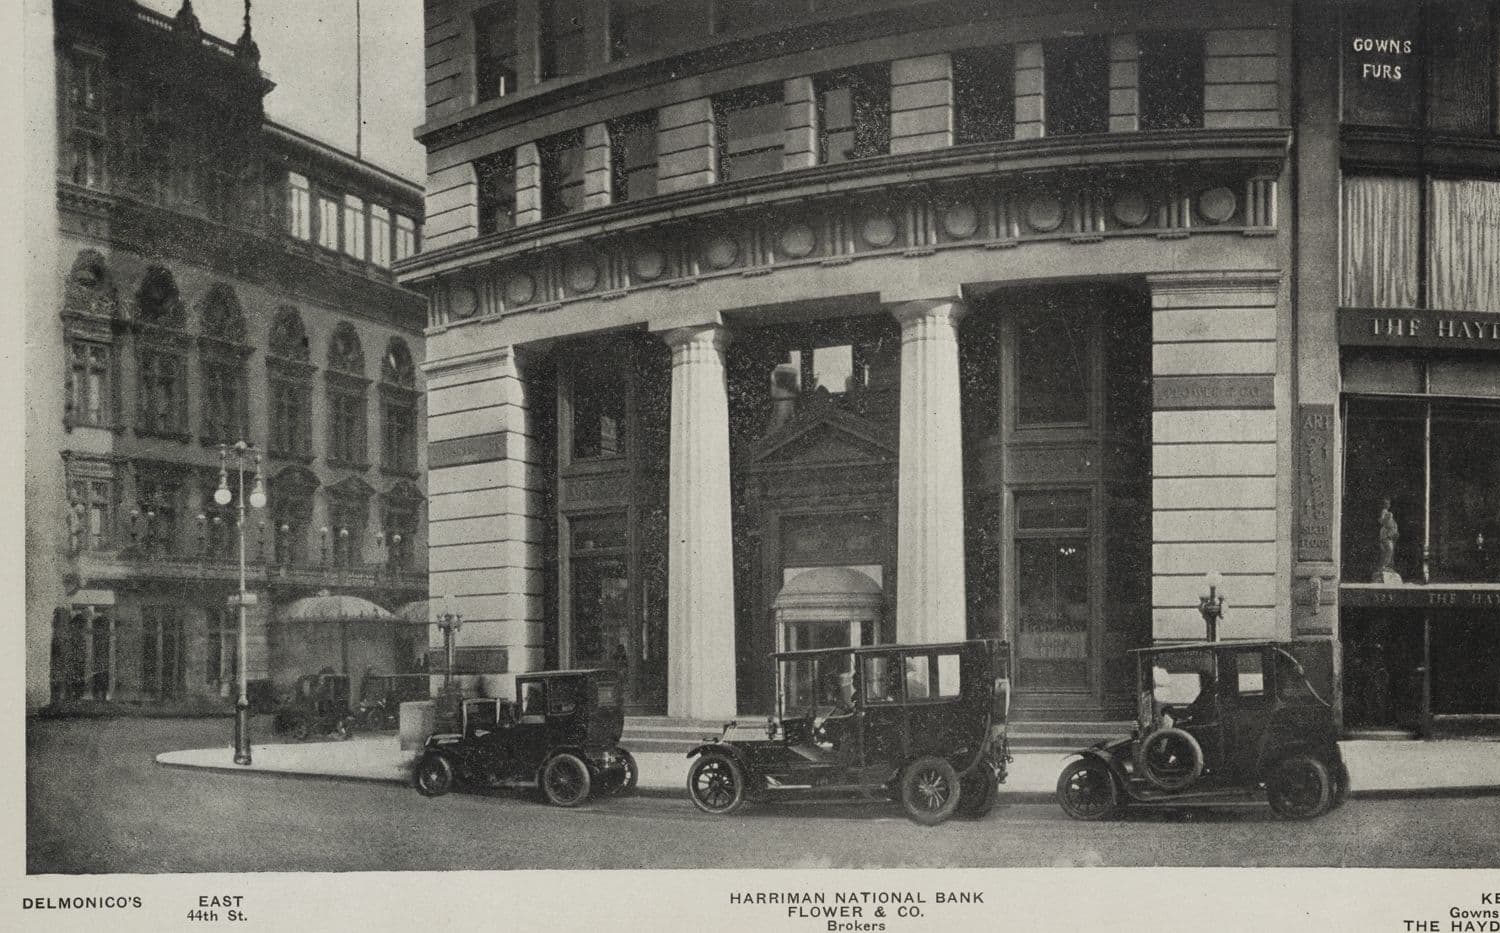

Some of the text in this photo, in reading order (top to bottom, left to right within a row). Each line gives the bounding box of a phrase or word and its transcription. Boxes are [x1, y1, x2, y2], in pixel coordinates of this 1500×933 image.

[1353, 38, 1412, 54] GOWNS
[1362, 63, 1402, 79] FURS
[1371, 317, 1421, 337] THE
